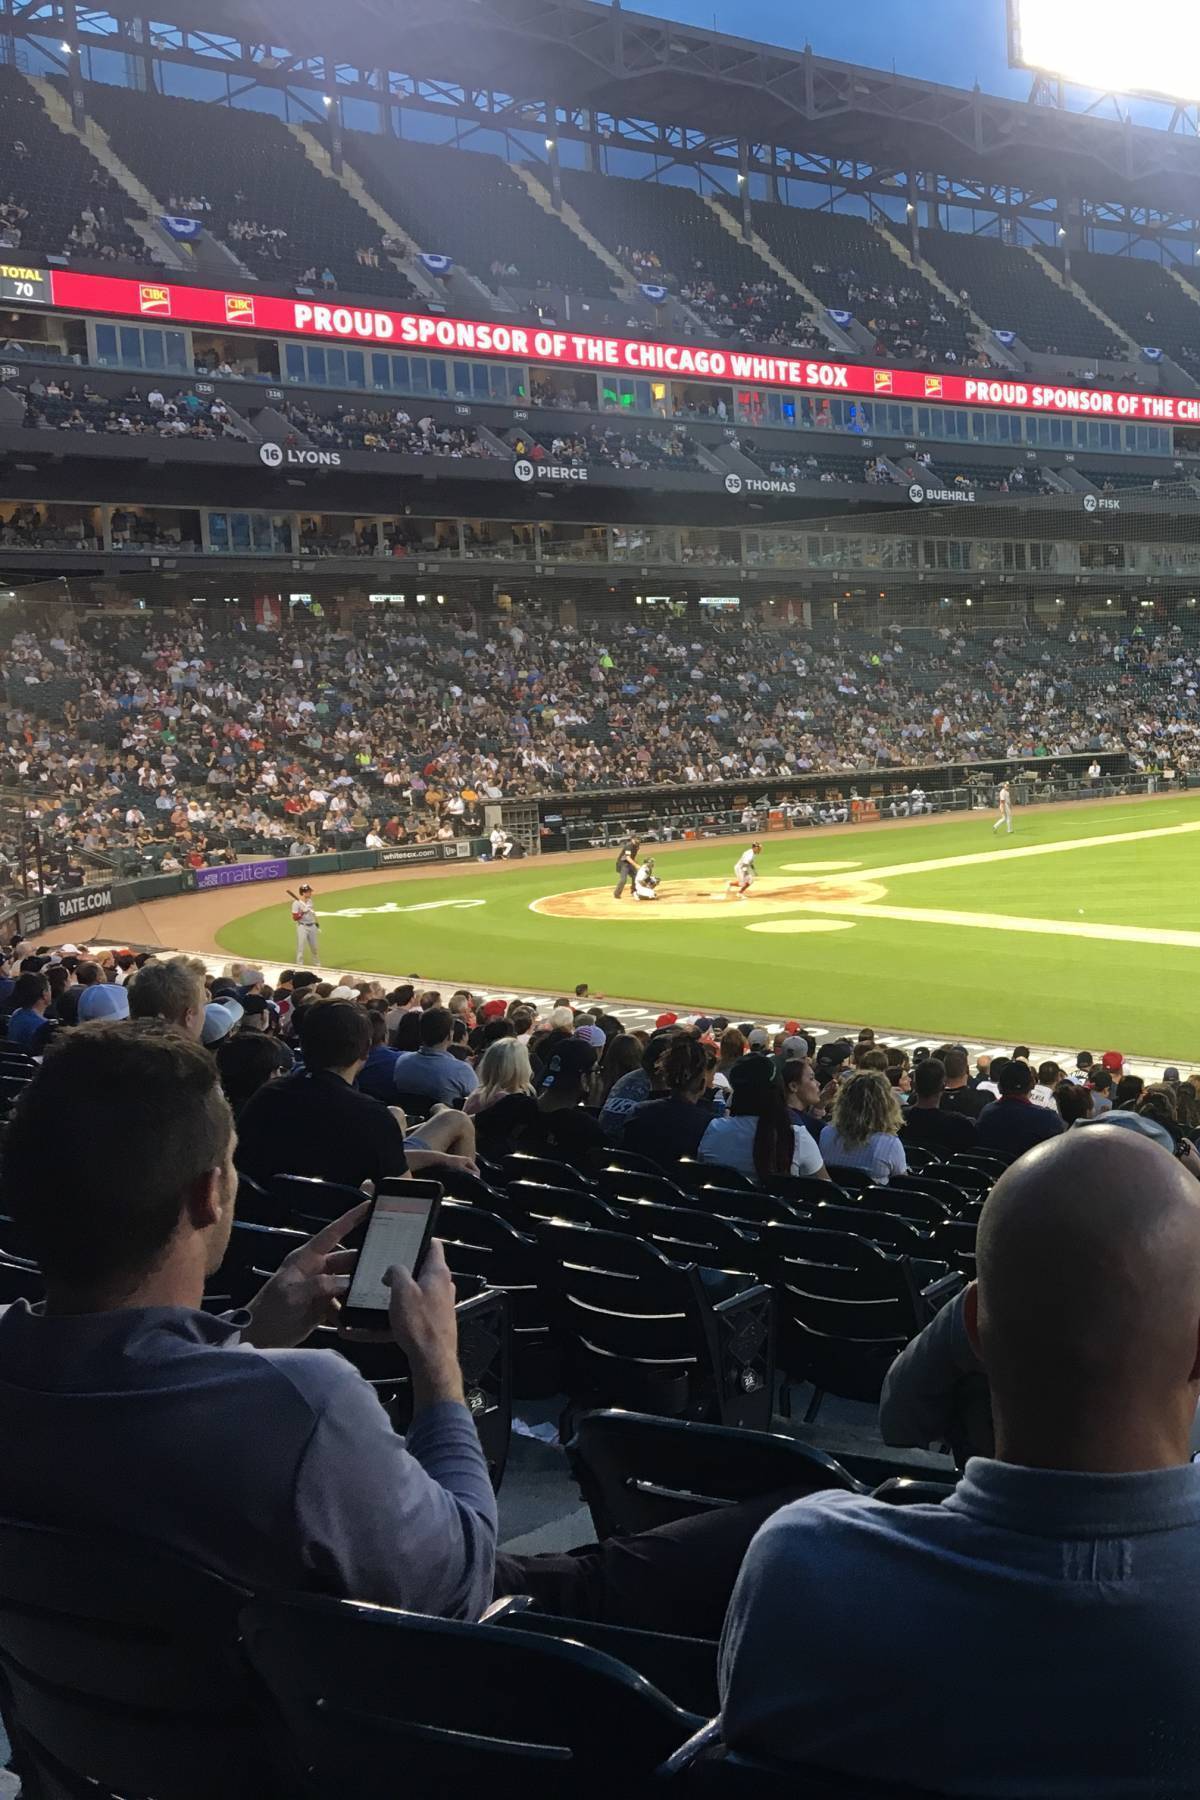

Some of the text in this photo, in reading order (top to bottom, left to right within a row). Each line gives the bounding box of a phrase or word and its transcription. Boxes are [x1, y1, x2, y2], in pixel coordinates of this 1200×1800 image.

[0, 265, 44, 282] TOTAL
[14, 281, 33, 297] 70
[142, 286, 167, 300] CIBC
[228, 297, 251, 311] CIBC
[293, 302, 849, 388] PROUD SPONSOR OF THE CHICAGO WHITE SOX
[964, 380, 1028, 406] PROUD
[1032, 386, 1113, 413] SPONSOR
[1117, 394, 1139, 415] OF
[1142, 397, 1174, 417] THE
[263, 446, 341, 466] 16 LYONS
[517, 464, 588, 480] 19 PIERCE
[726, 477, 797, 493] 35 THOMAS
[911, 487, 975, 502] 56 BUEHRLE
[1098, 498, 1120, 509] FISK
[383, 848, 435, 861] whitesox.com
[58, 890, 112, 918] RATE.COM
